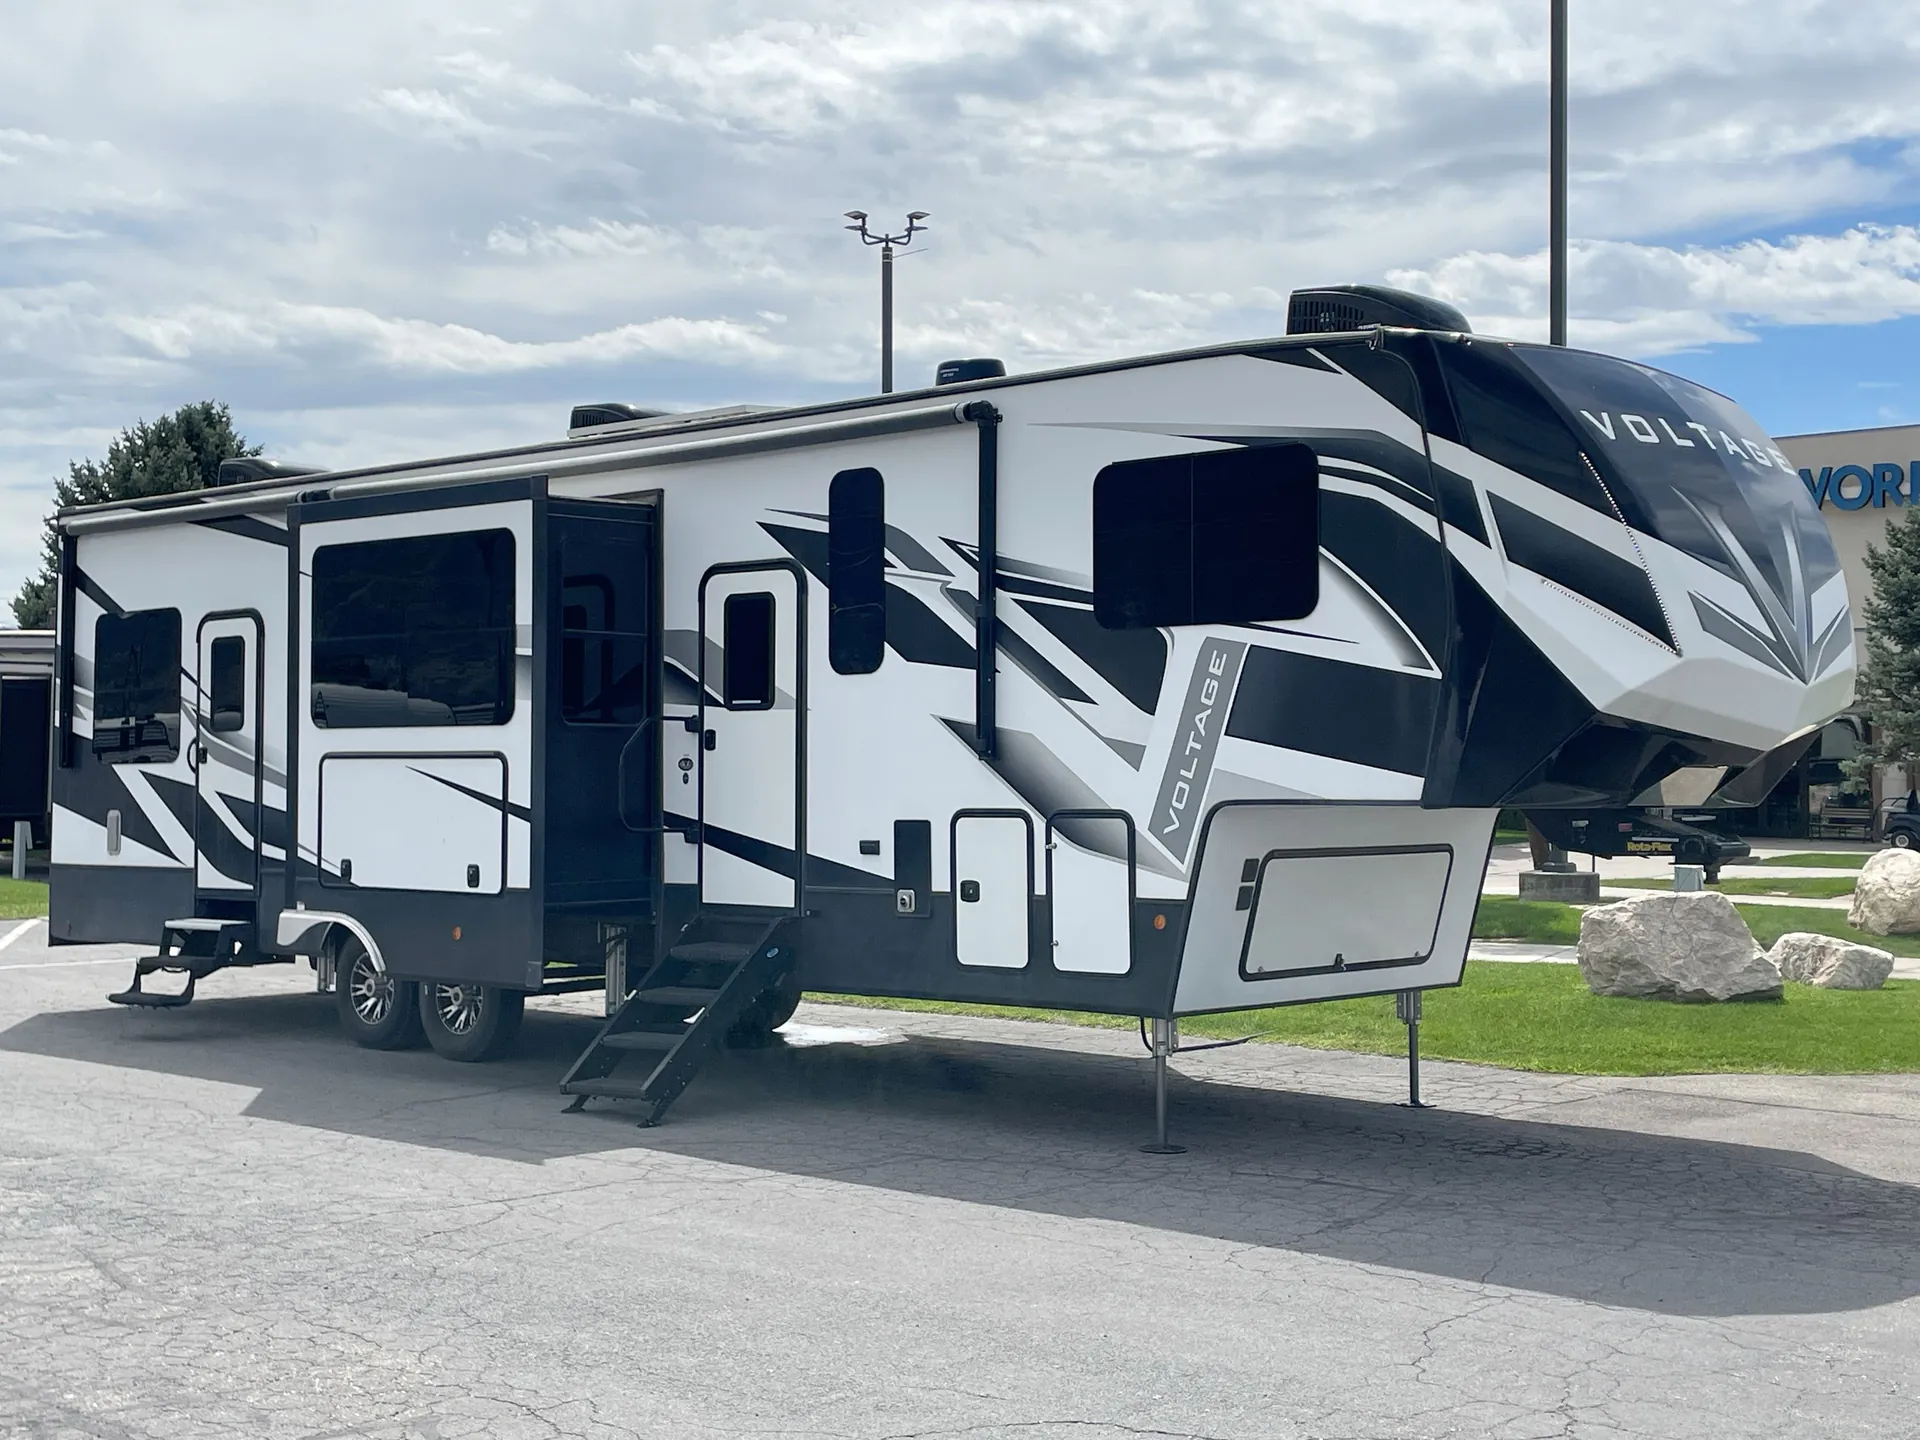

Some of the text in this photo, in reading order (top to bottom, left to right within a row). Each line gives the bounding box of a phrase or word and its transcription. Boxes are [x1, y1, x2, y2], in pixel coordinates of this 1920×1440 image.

[1580, 410, 1797, 476] VOLTAGE
[1798, 461, 1920, 511] OR
[1163, 649, 1227, 834] VOLTAGE
